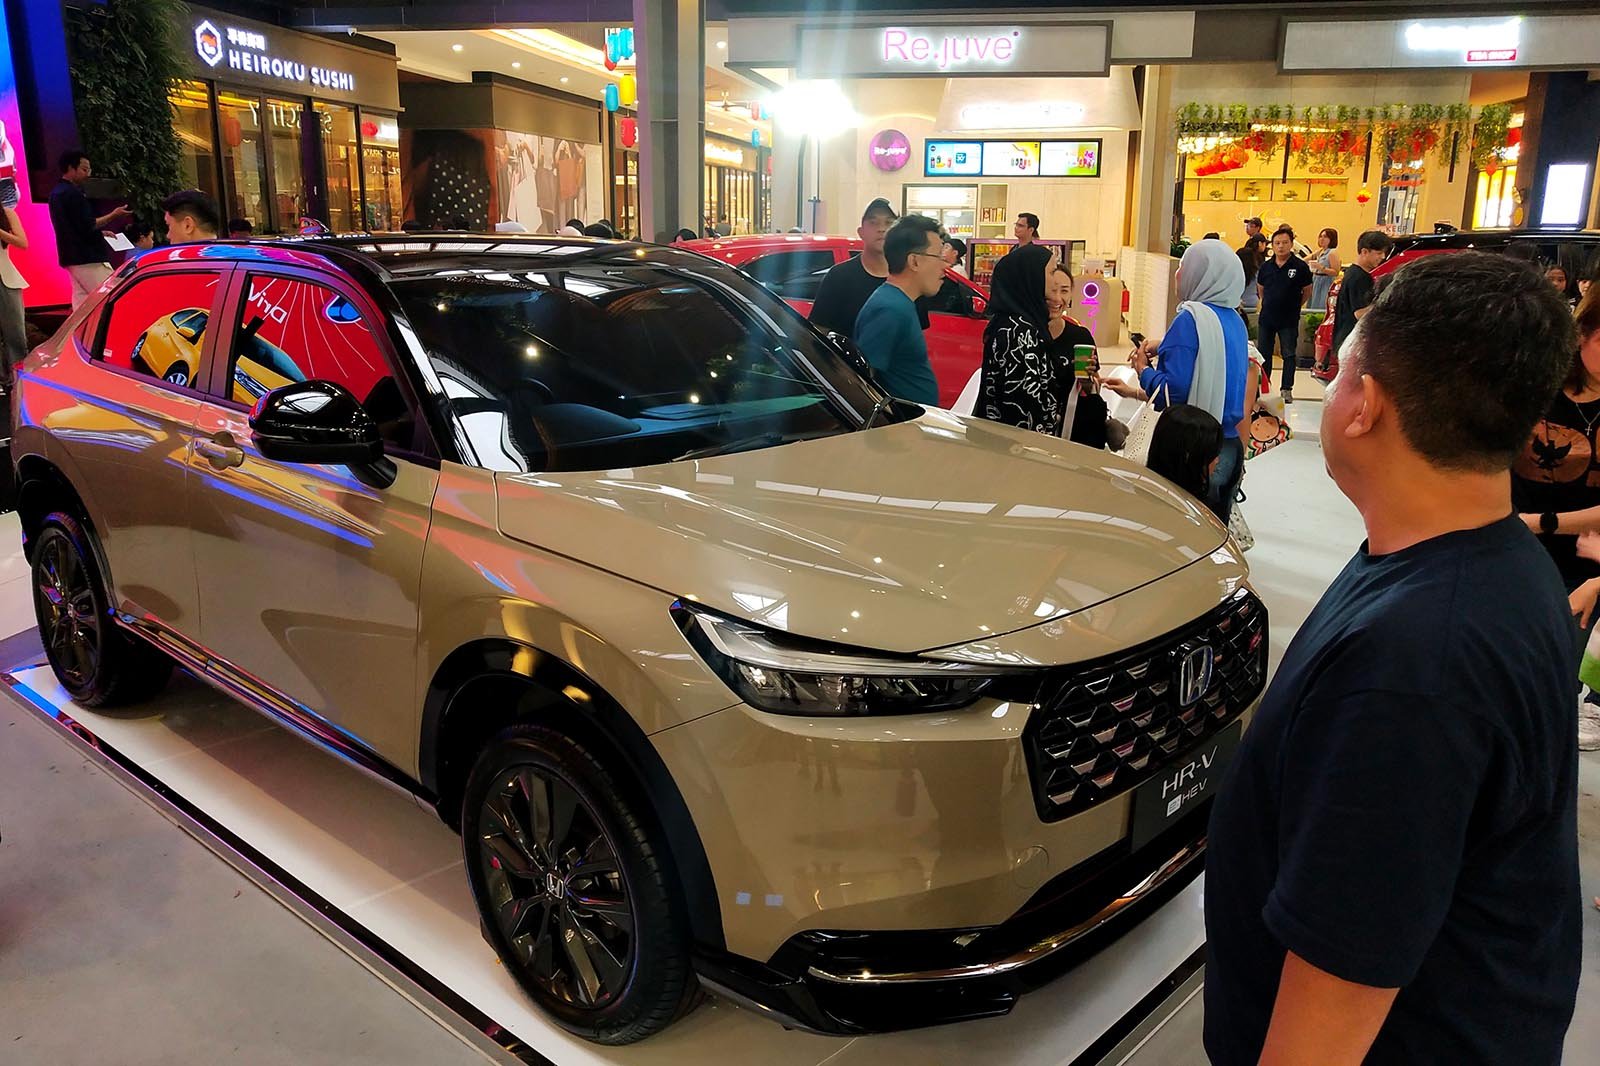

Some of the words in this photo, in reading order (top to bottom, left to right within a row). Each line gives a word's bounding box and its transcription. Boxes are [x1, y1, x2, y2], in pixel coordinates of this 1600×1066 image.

[229, 49, 306, 81] HEIROKU
[310, 67, 354, 91] SUSHI
[1162, 745, 1218, 799] HR-V
